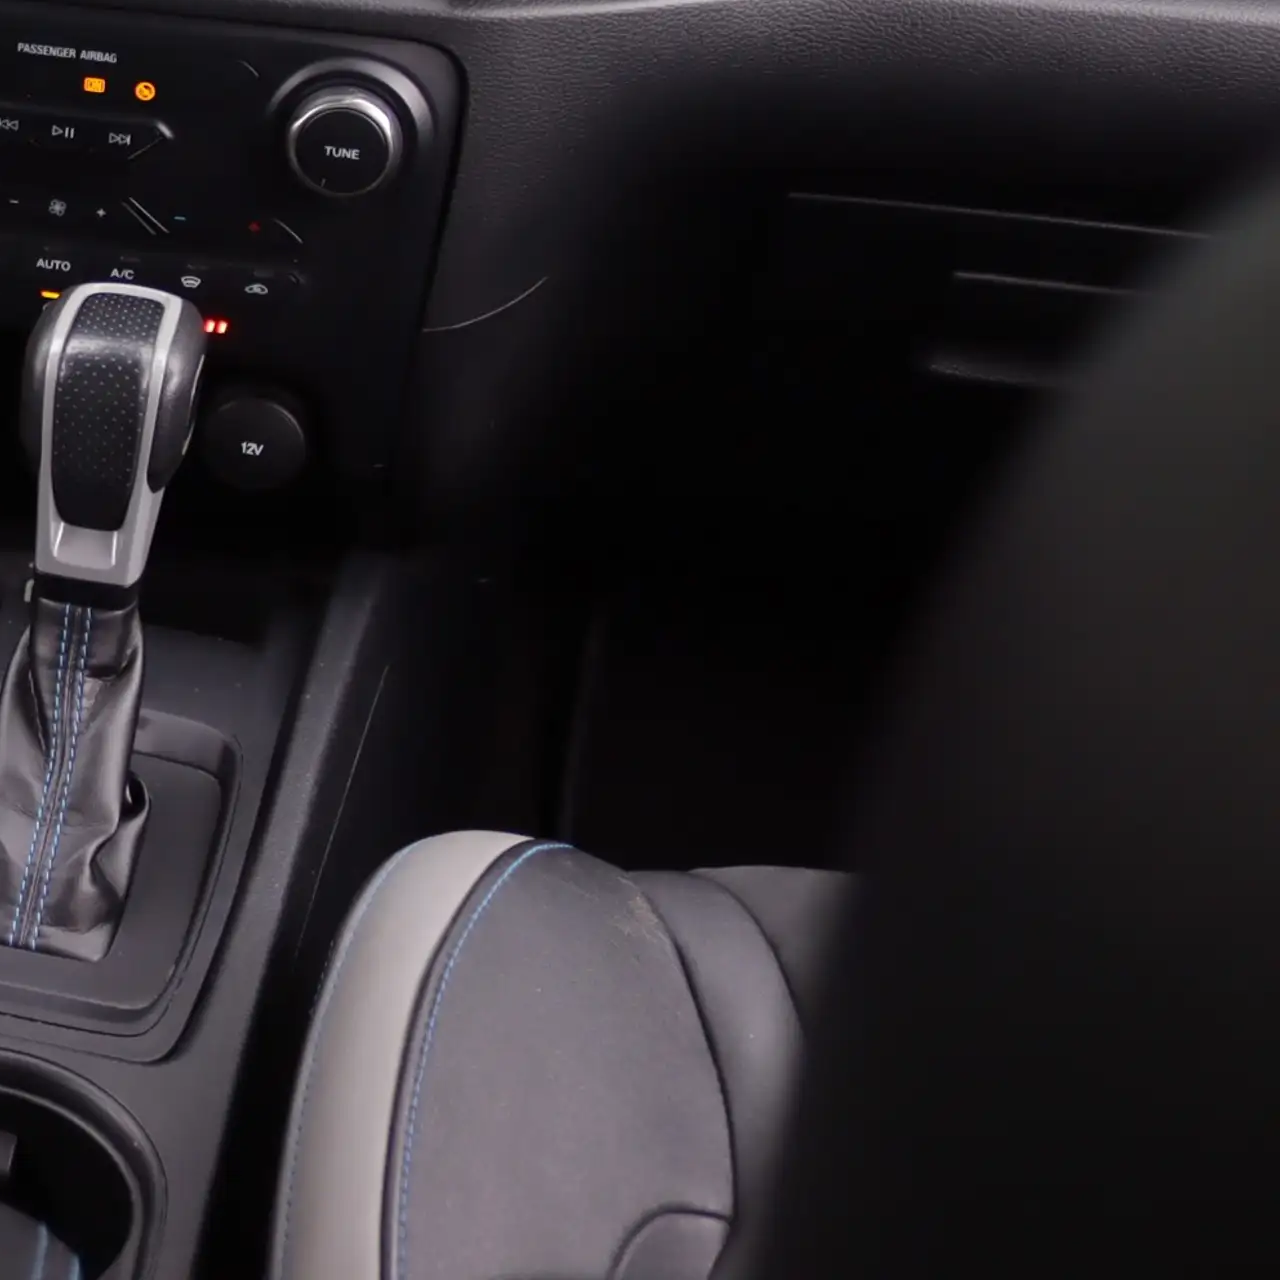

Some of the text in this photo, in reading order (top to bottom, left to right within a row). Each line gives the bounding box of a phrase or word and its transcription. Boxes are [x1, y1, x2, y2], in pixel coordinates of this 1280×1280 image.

[17, 42, 118, 64] PASSENGER AIRBAG
[324, 145, 361, 160] TUNE
[36, 258, 71, 272] AUTO
[110, 268, 135, 280] A/C
[240, 441, 264, 456] 12V
